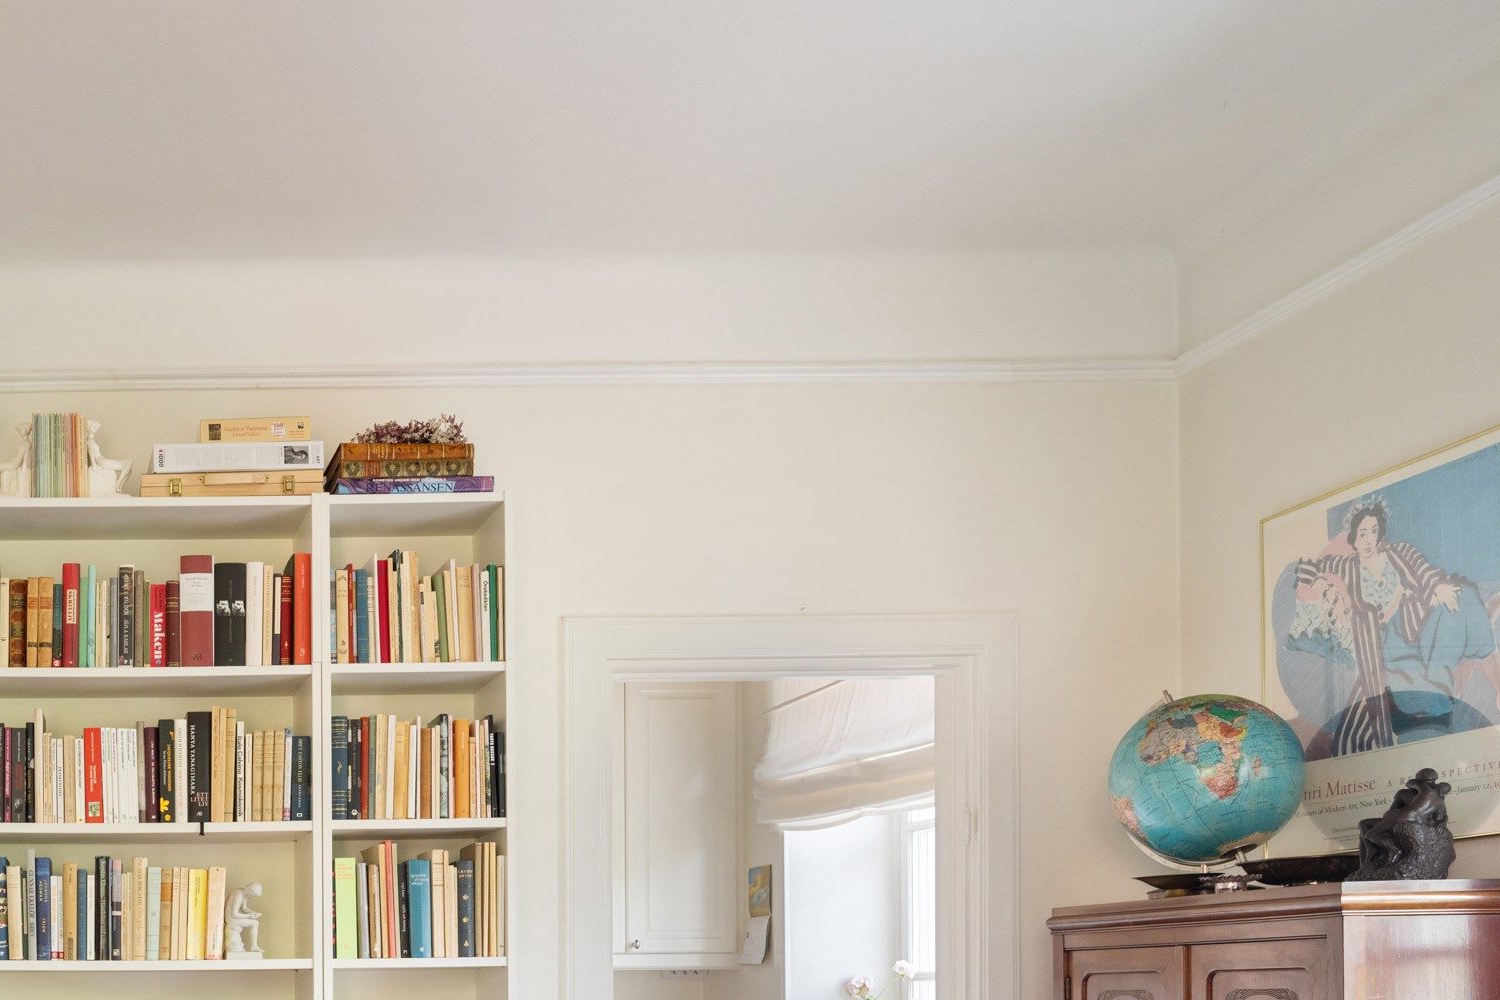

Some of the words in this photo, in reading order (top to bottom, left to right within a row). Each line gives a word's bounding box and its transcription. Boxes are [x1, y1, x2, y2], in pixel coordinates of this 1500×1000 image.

[154, 612, 165, 660] Maken
[1304, 786, 1322, 800] nri
[1326, 780, 1376, 798] Matisse
[1324, 805, 1347, 814] Modern
[1360, 800, 1372, 808] New
[1374, 798, 1387, 806] York
